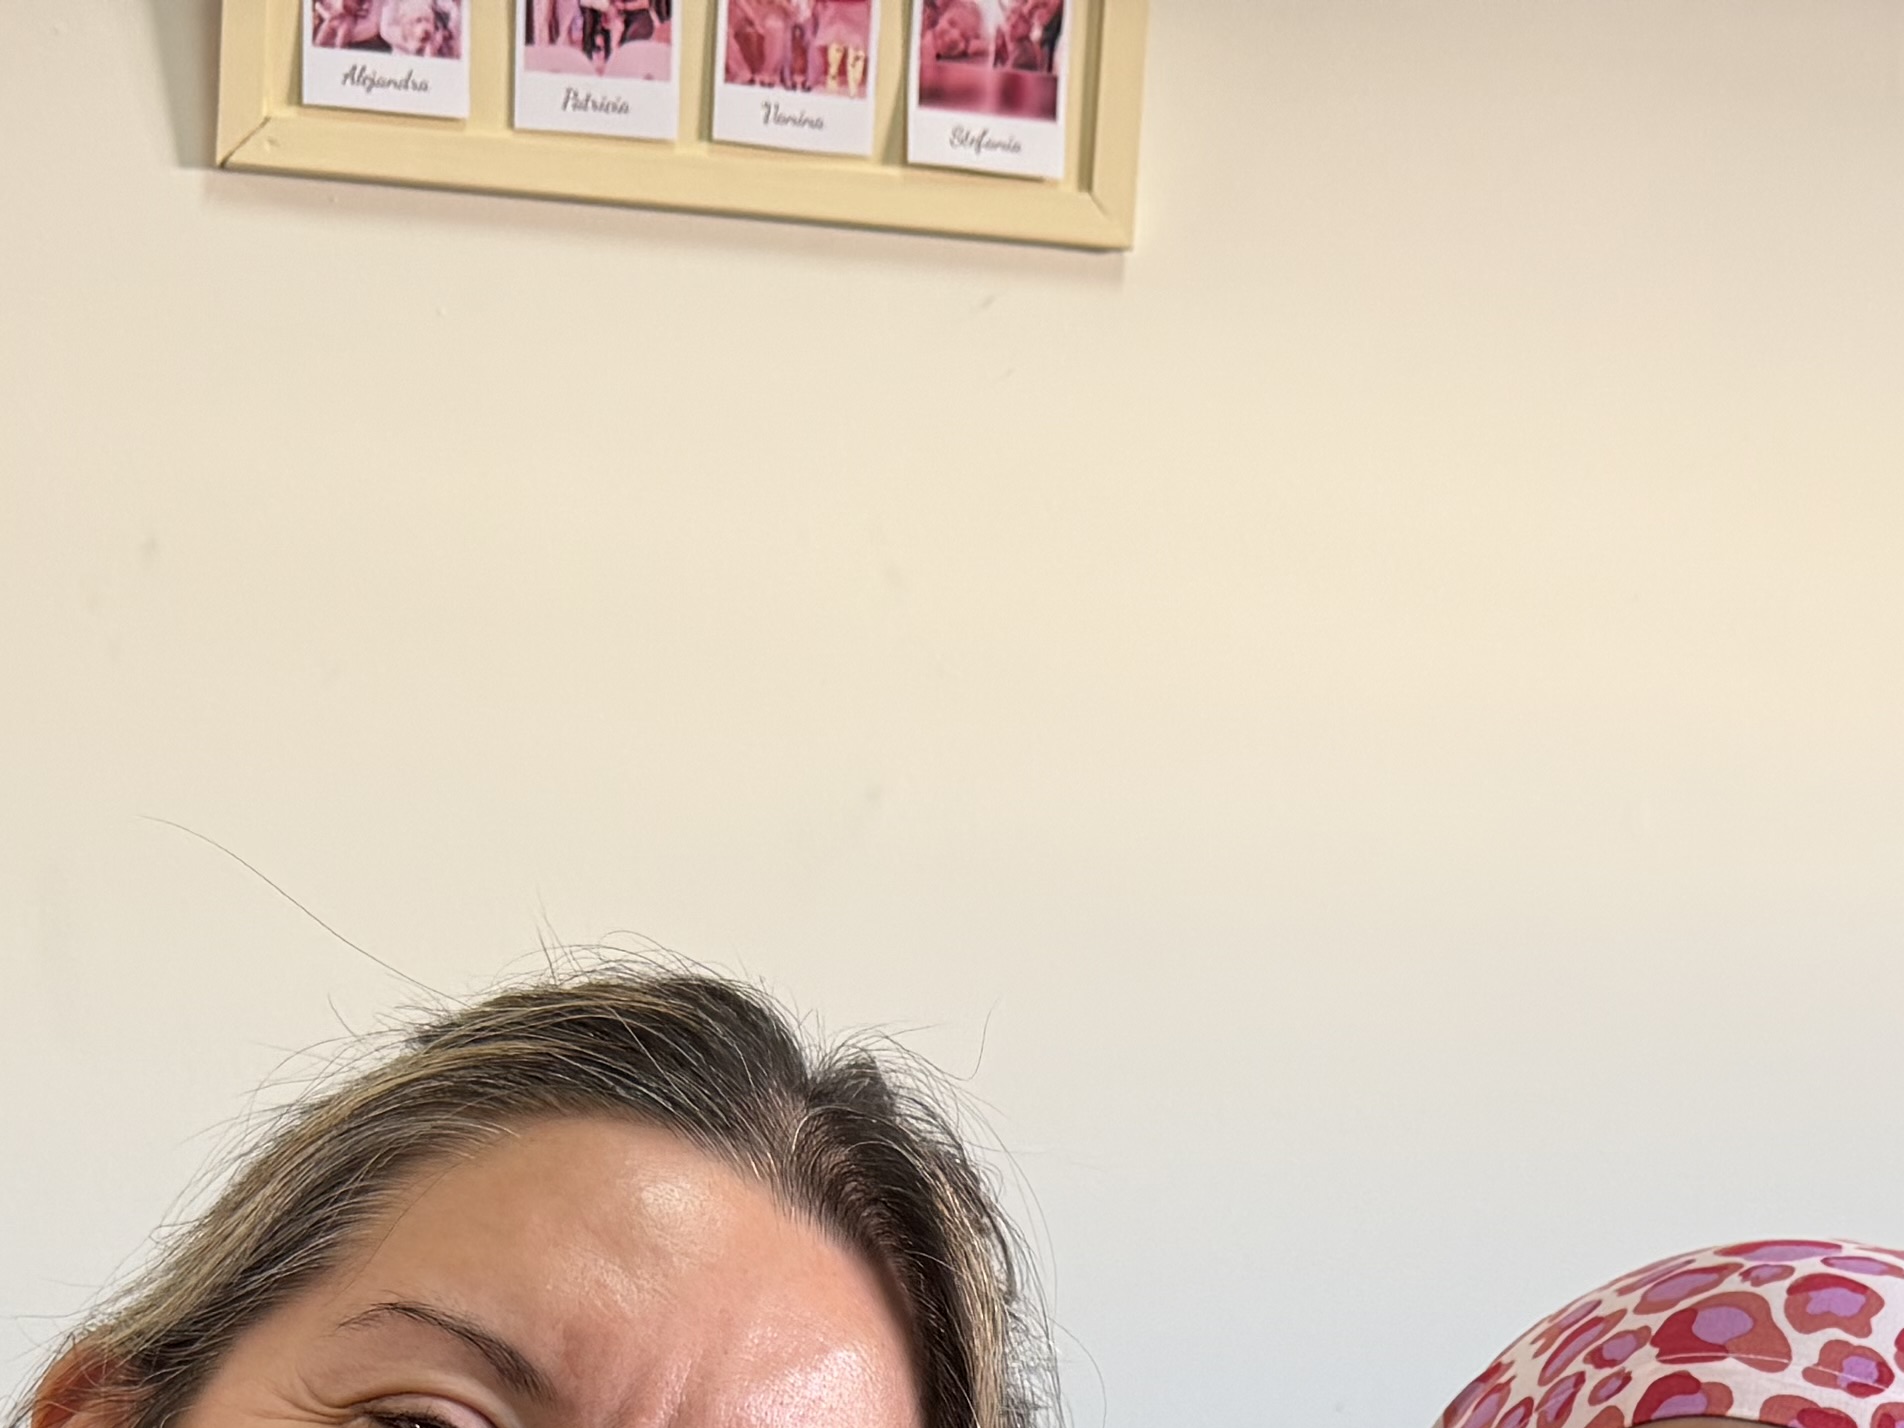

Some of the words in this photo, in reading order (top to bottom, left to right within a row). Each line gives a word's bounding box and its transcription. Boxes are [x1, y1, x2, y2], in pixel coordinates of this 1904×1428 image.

[341, 64, 430, 93] Alejandra
[561, 86, 631, 115] Patricia
[949, 124, 1022, 155] Stefania
